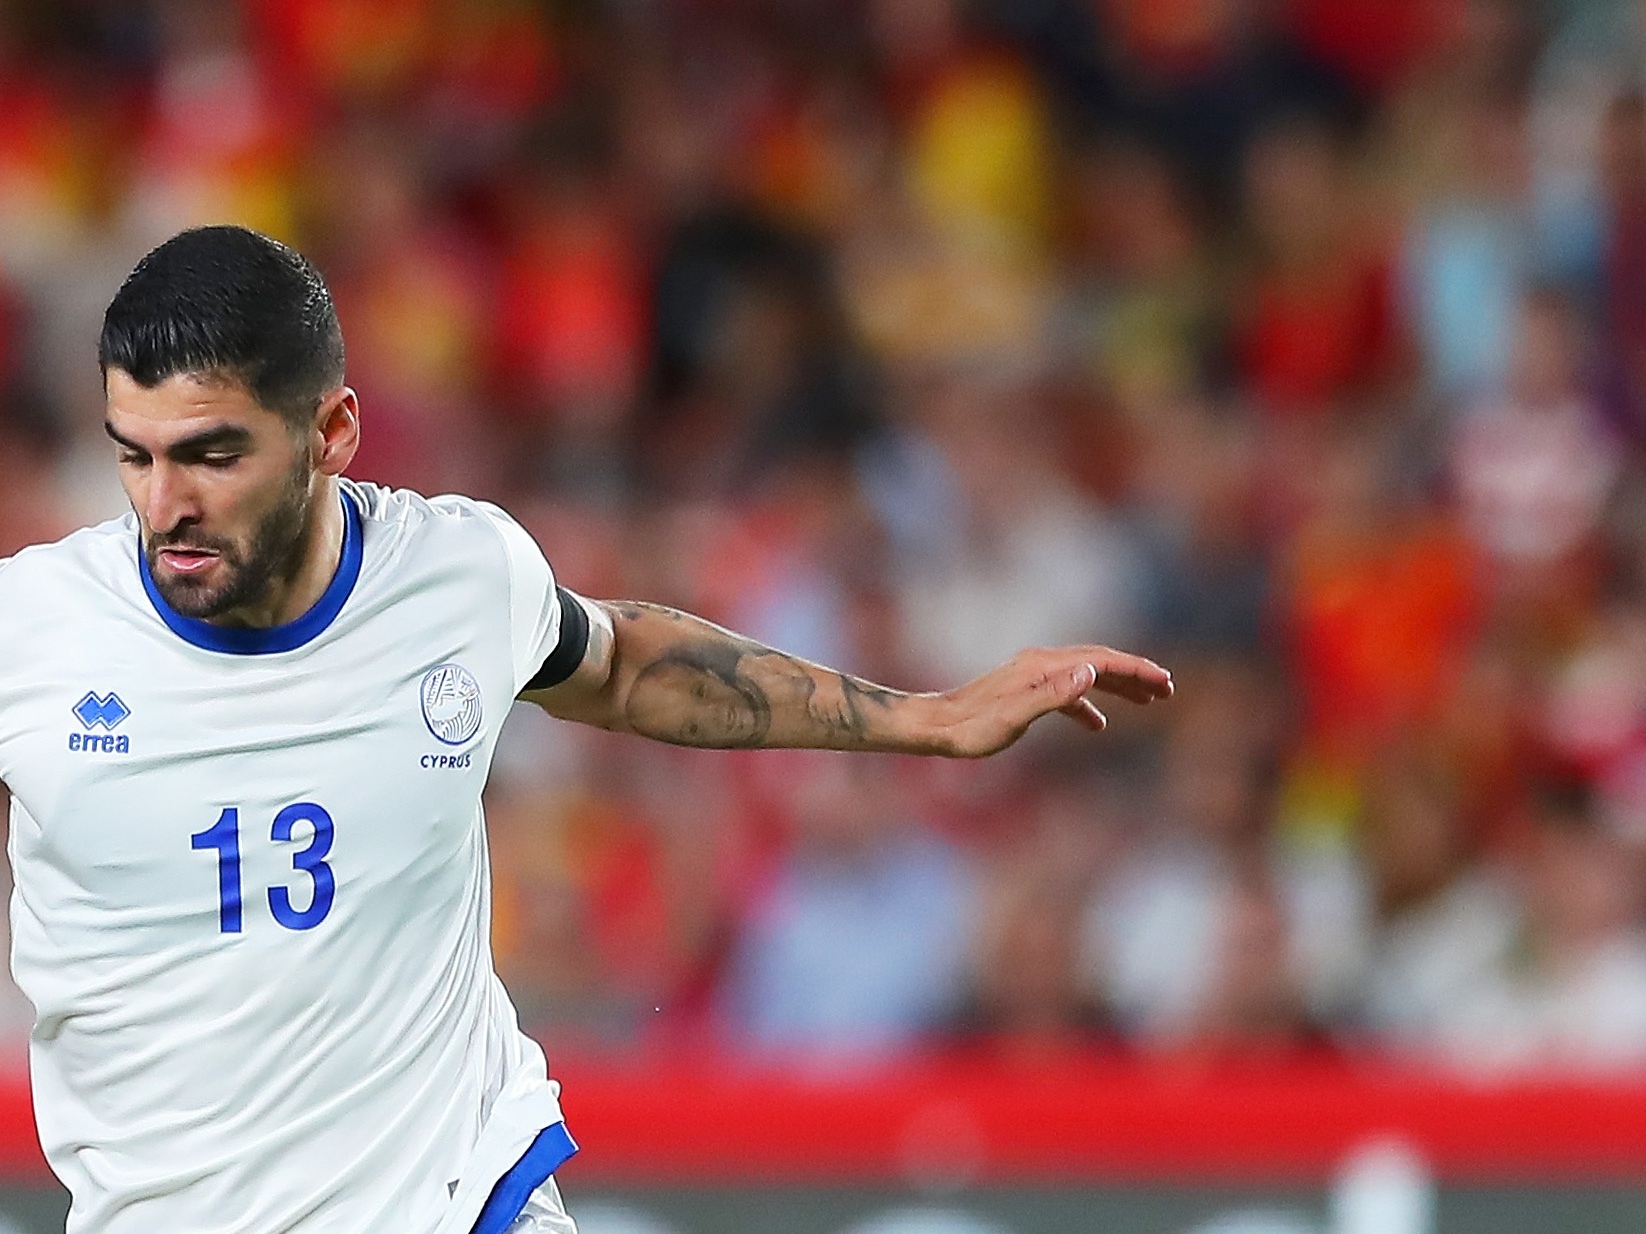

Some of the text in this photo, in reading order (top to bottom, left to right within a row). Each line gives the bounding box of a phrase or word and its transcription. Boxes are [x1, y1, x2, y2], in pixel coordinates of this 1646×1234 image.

[68, 732, 130, 754] errea
[420, 754, 471, 769] CYPRUS
[190, 801, 336, 935] 13
